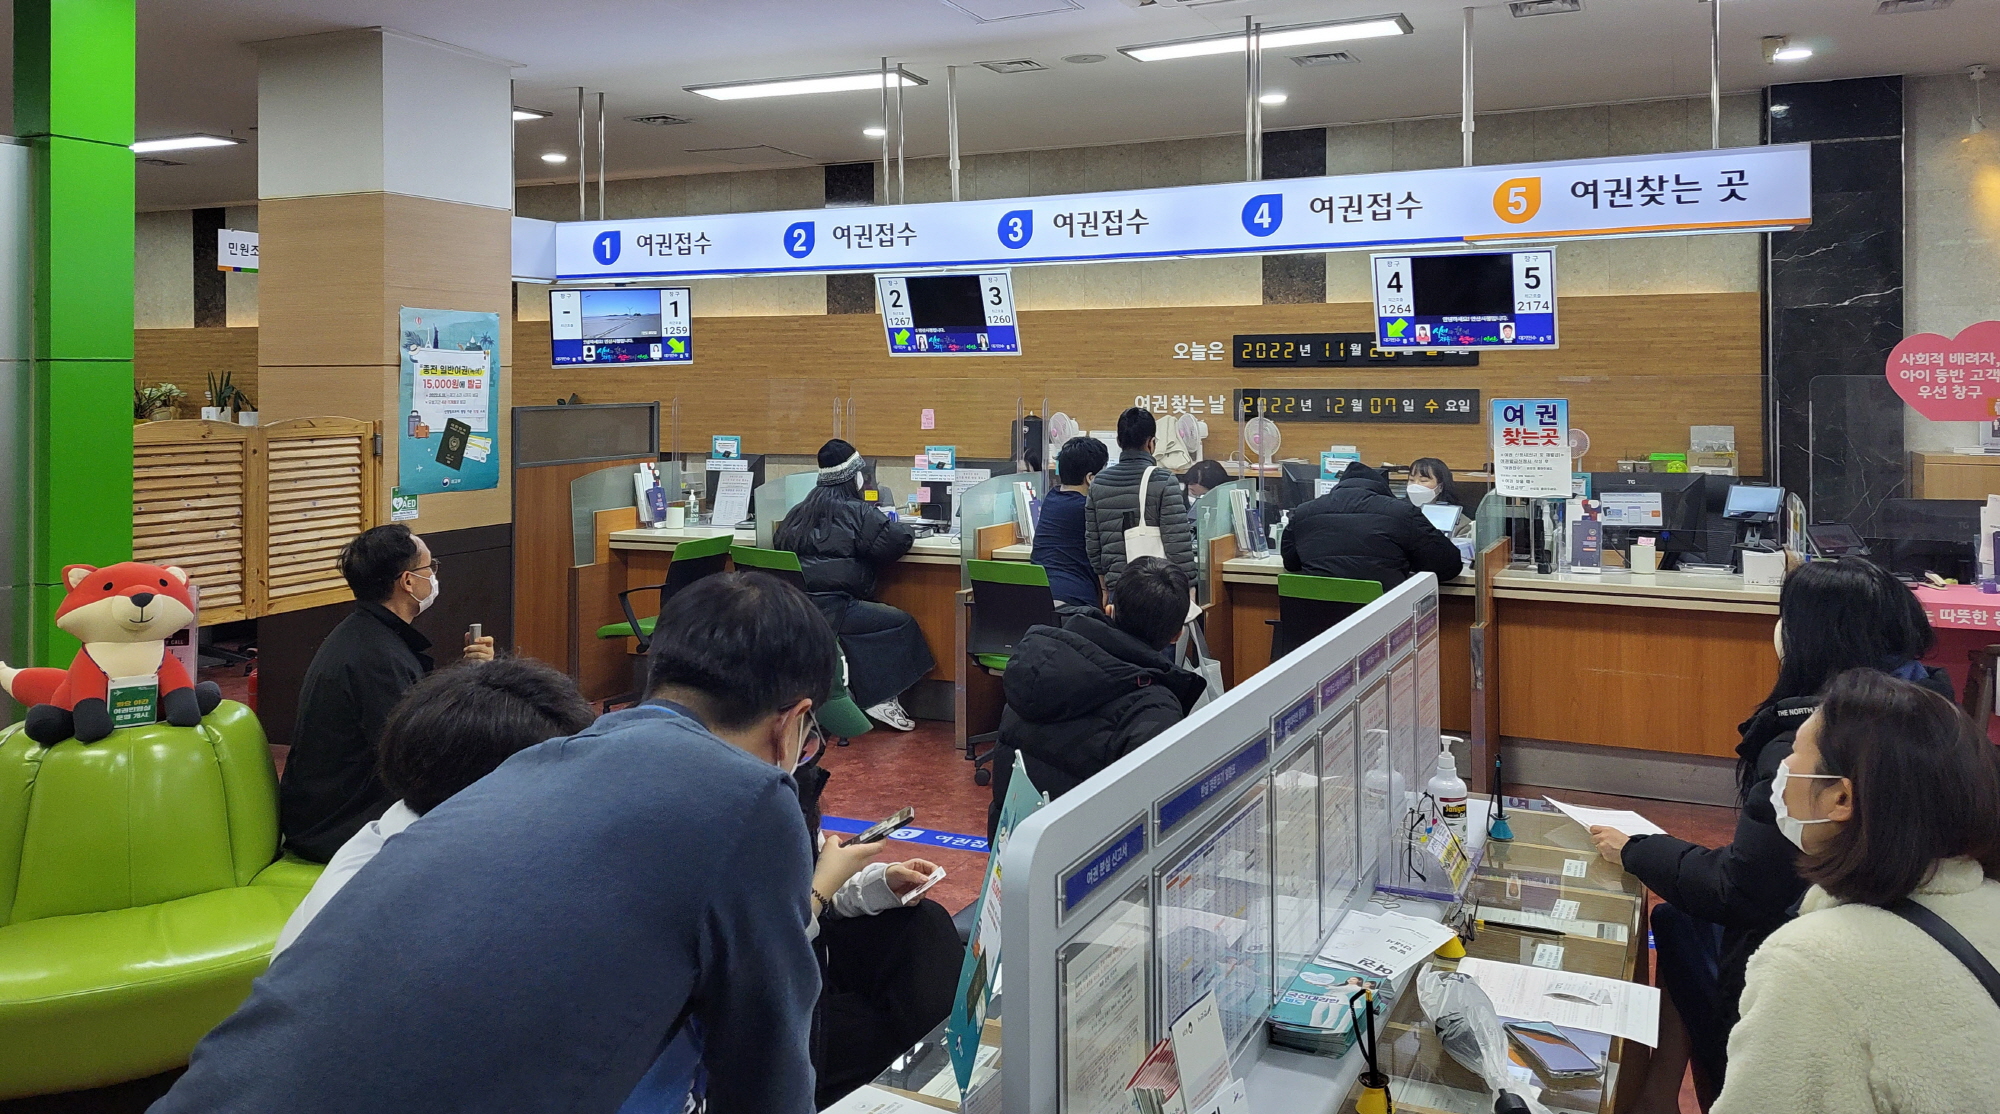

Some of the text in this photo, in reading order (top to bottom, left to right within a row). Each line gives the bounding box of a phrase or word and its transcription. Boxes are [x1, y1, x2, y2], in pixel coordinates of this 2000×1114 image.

[1508, 169, 1749, 215] 5 여권찾는 곳
[1254, 191, 1423, 229] 4 여권접수
[1007, 208, 1149, 242] 3 여권접수
[602, 231, 712, 258] 1 여권접수
[793, 221, 917, 252] 2 여권접수
[1387, 271, 1403, 293] 4
[1524, 266, 1541, 289] 5
[889, 289, 903, 308] 2
[988, 286, 1002, 306] 3
[669, 300, 678, 318] 1
[1382, 304, 1412, 314] 1264
[1517, 301, 1550, 311] 2174
[889, 317, 911, 326] 1267
[988, 315, 1011, 324] 1260
[664, 326, 688, 335] 1259
[1172, 341, 1225, 361] 오늘은
[1899, 352, 1944, 367] 사회적
[467, 379, 482, 390] 발급
[1900, 369, 1930, 383] 아이
[1934, 368, 1965, 384] 동반
[1917, 384, 1983, 400] 우선 창구
[1135, 395, 1168, 414] 여권
[1170, 395, 1206, 414] 찾는
[1208, 395, 1226, 414] 날
[1502, 427, 1559, 446] 찾는곳
[402, 499, 417, 508] AED
[1940, 608, 1988, 625] 따뜻한
[1777, 709, 1789, 717] THE
[1789, 707, 1814, 716] NORTH
[1086, 842, 1128, 884] 여권 분실 신고서
[1357, 957, 1394, 975] 여권
